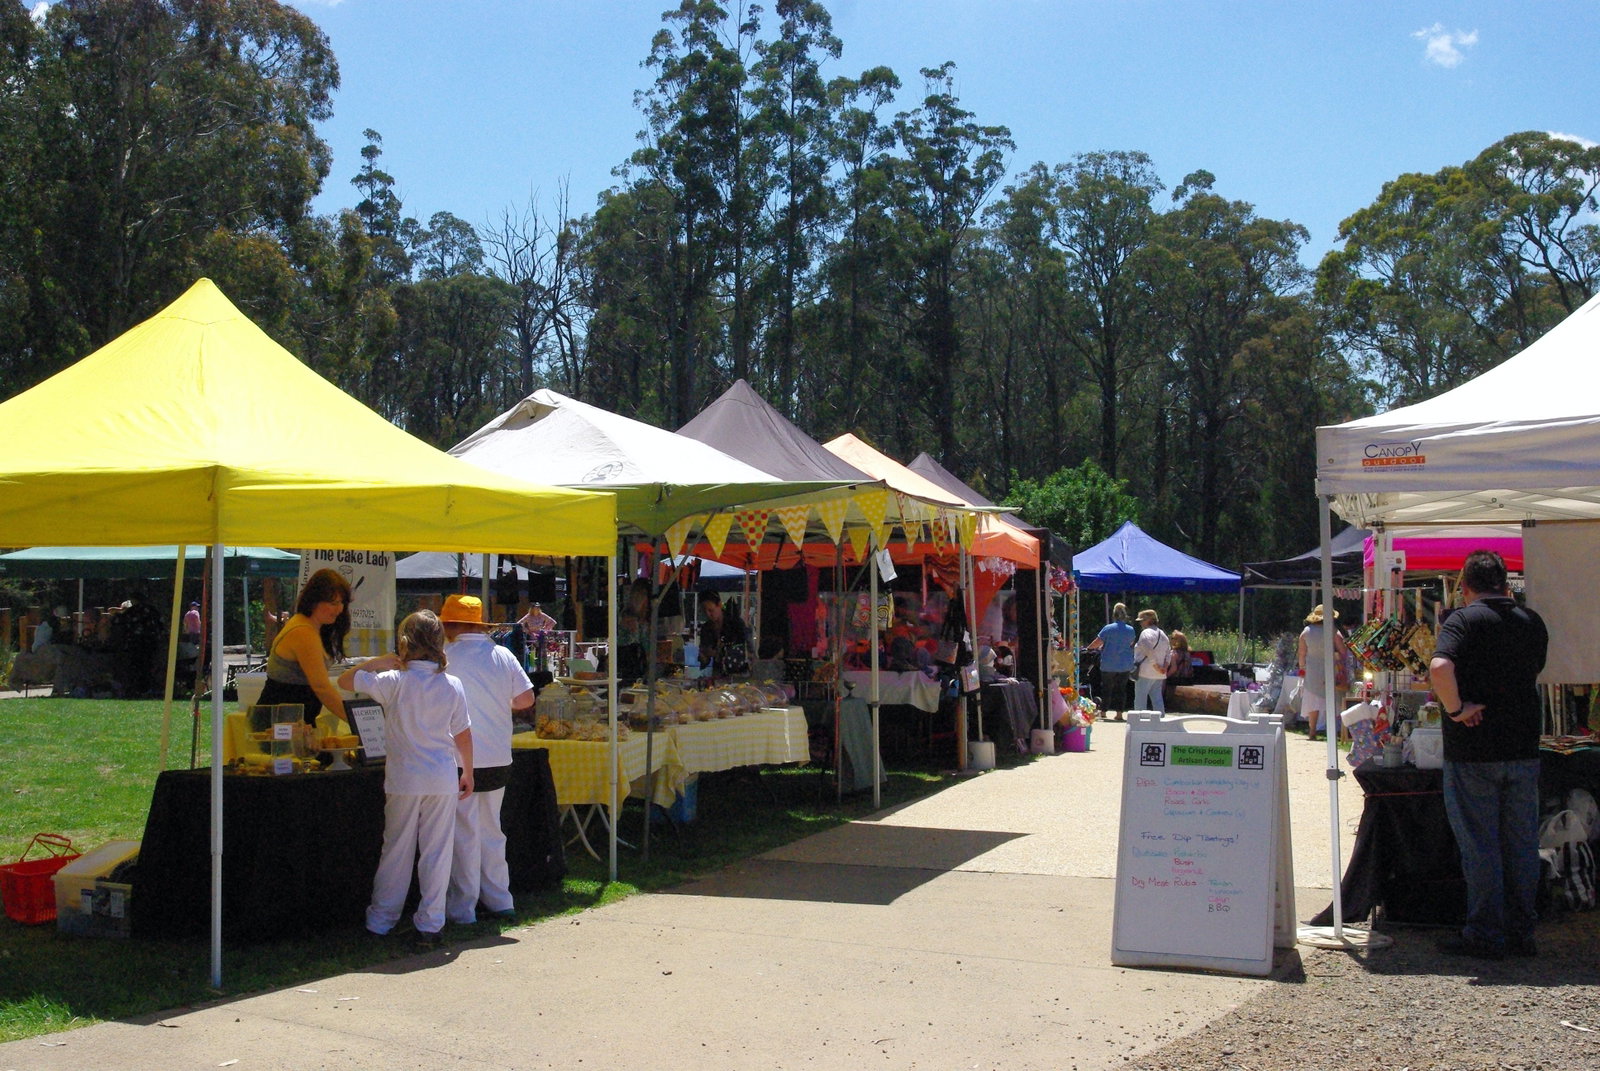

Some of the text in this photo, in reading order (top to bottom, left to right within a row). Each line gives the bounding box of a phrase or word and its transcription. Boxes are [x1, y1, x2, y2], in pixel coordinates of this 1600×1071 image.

[1364, 441, 1422, 458] CANOPY
[1363, 457, 1424, 466] outdoor
[313, 549, 391, 570] The Cake Lady
[1173, 746, 1232, 756] The Crisp House
[1178, 757, 1225, 765] Artisan Foods
[1141, 831, 1166, 840] Free
[1172, 832, 1192, 843] Dip
[1131, 876, 1145, 889] Dry
